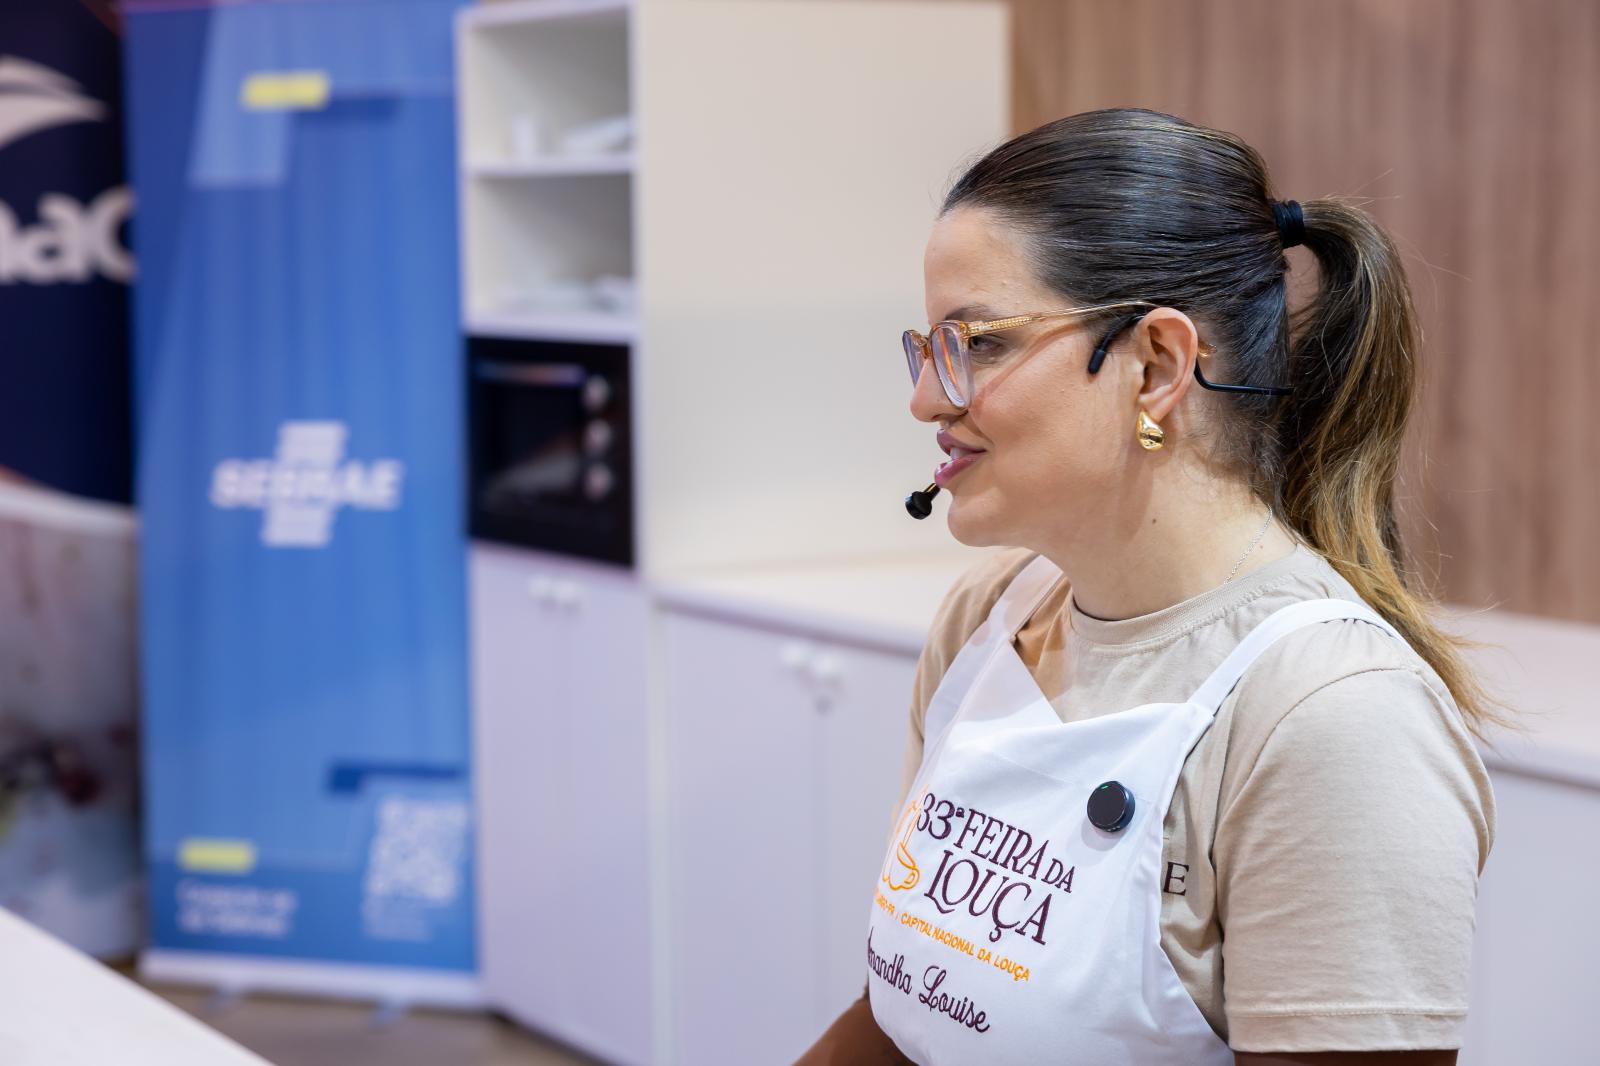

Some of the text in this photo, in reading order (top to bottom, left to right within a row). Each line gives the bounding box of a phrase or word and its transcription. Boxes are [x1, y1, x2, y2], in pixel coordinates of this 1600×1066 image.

[210, 458, 403, 510] SEBRAE
[953, 808, 1049, 880] FEIRA
[1041, 858, 1075, 893] DA
[924, 850, 1053, 945] LOUÇA
[901, 912, 1031, 983] CAPITAL NACIONAL DA LOUÇA
[919, 965, 990, 1033] Louise
